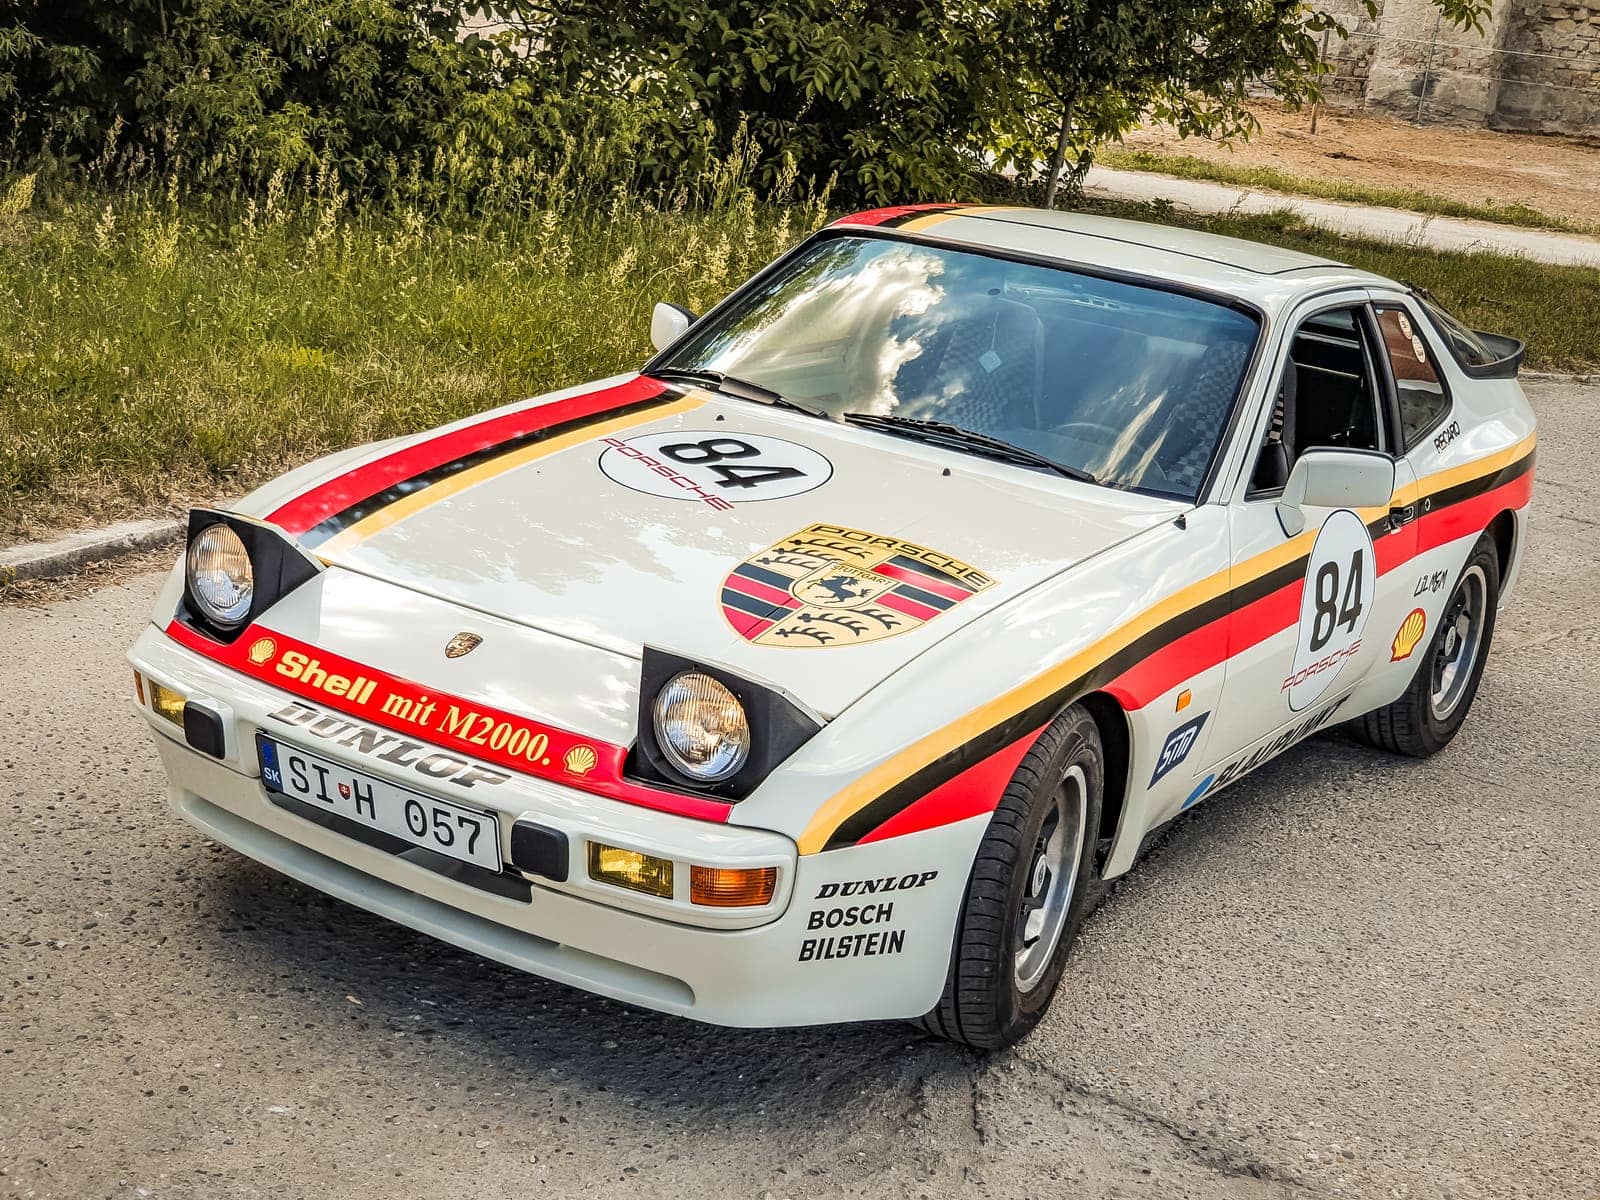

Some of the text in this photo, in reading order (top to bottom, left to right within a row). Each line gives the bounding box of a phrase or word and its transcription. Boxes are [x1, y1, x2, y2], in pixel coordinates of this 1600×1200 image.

[658, 438, 808, 489] 84
[1433, 420, 1460, 454] RECARO
[598, 437, 735, 511] PORSCHE
[811, 525, 991, 587] PORSCHE
[830, 564, 890, 587] STUTTGART
[1309, 548, 1363, 652] 84
[1280, 638, 1362, 694] PORSCHE
[275, 650, 550, 766] Shell mit M2000.
[267, 701, 513, 788] DUNLOP
[263, 767, 281, 784] SK
[404, 799, 481, 855] 057
[814, 870, 939, 900] DUNLOP
[807, 902, 894, 931] BOSCH
[798, 929, 906, 962] BILSTEIN
